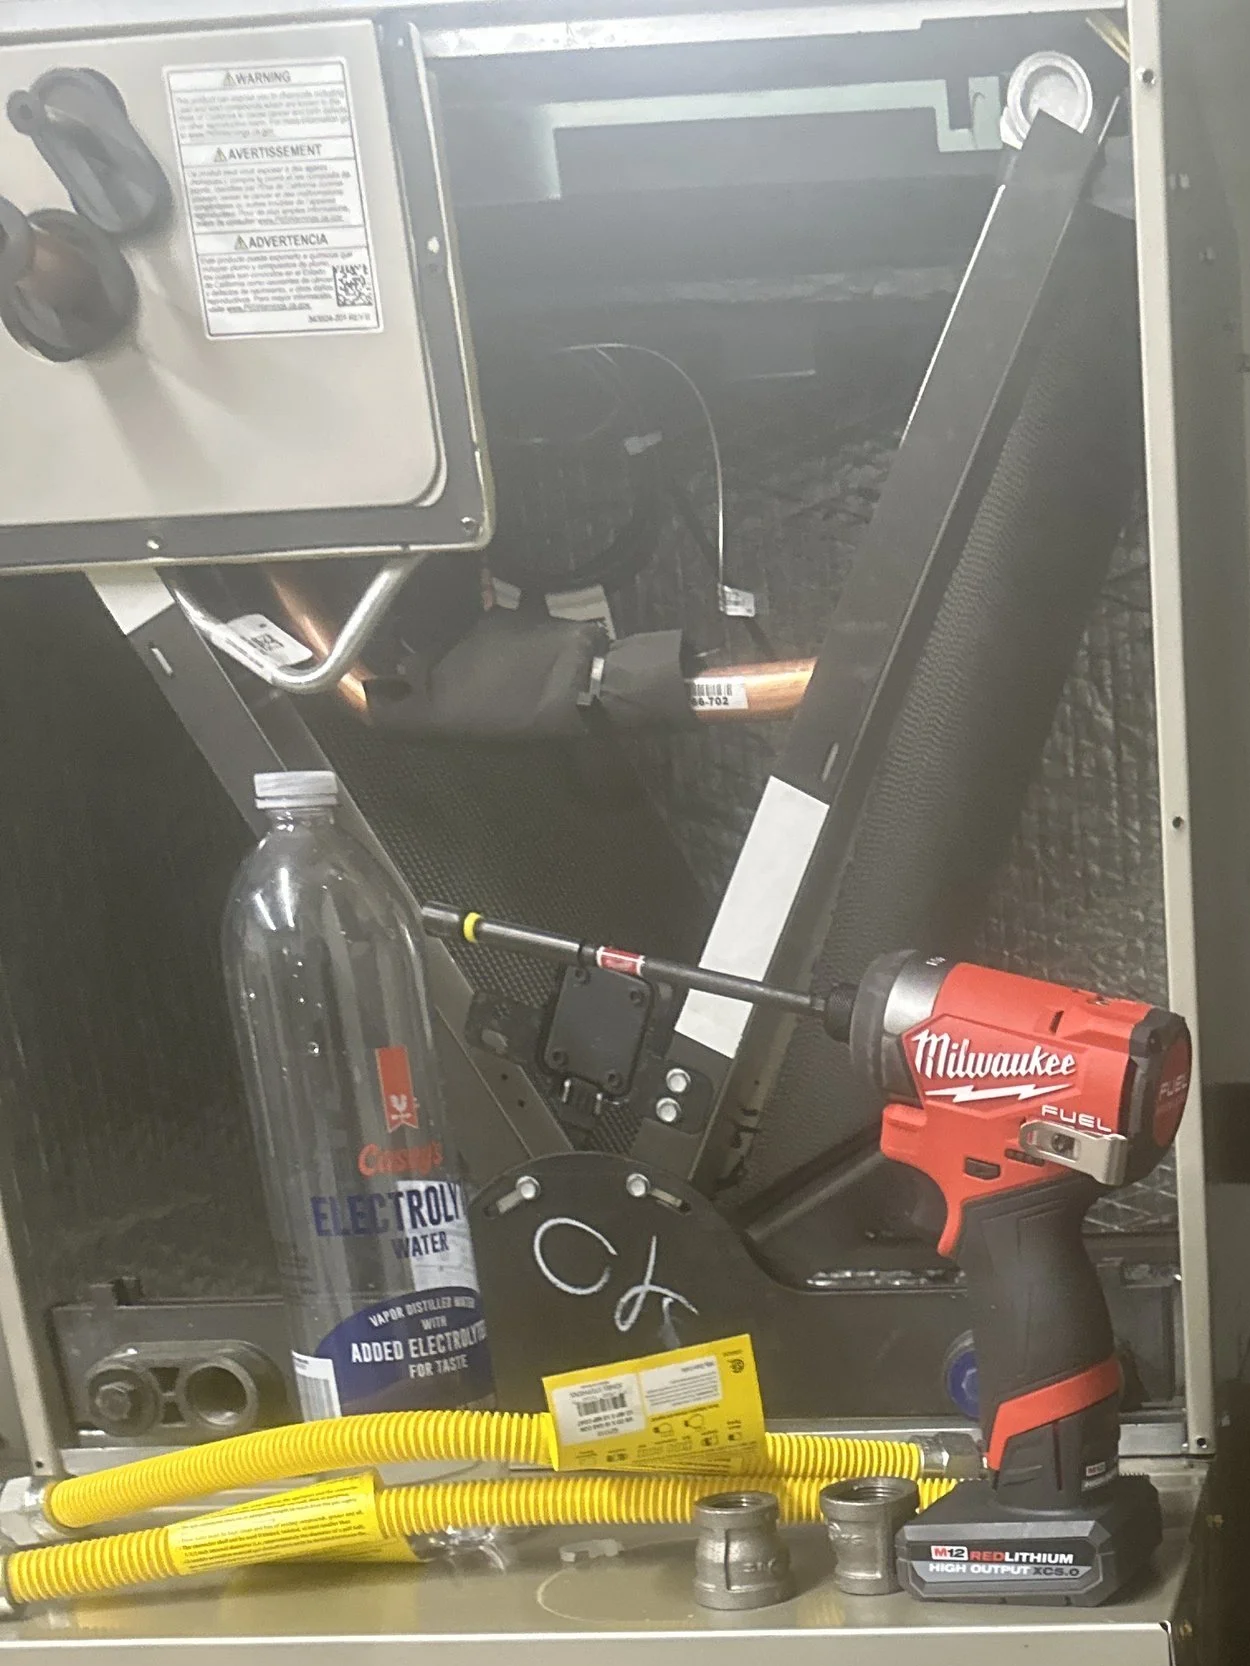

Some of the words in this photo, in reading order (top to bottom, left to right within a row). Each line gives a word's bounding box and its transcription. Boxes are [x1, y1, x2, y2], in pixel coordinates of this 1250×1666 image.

[235, 70, 291, 84] WARNING
[228, 143, 322, 160] AVERTISSEMENT
[250, 233, 328, 248] ADVERTENCIA
[911, 1028, 1077, 1079] Milwaukee
[1041, 1104, 1112, 1133] FUEL
[391, 1230, 449, 1259] WATER
[368, 1307, 405, 1327] VAPOR
[406, 1296, 452, 1316] DISTILLED
[420, 1316, 447, 1330] WITH
[352, 1340, 404, 1363] ADDED
[409, 1362, 433, 1379] FOR
[437, 1354, 468, 1375] TASTE
[933, 1547, 966, 1559] M12
[970, 1550, 1074, 1565] REDLITHIUM
[929, 1563, 967, 1574] HIGH
[970, 1564, 1031, 1575] OUTPUT
[1033, 1566, 1080, 1577] XC5.0
